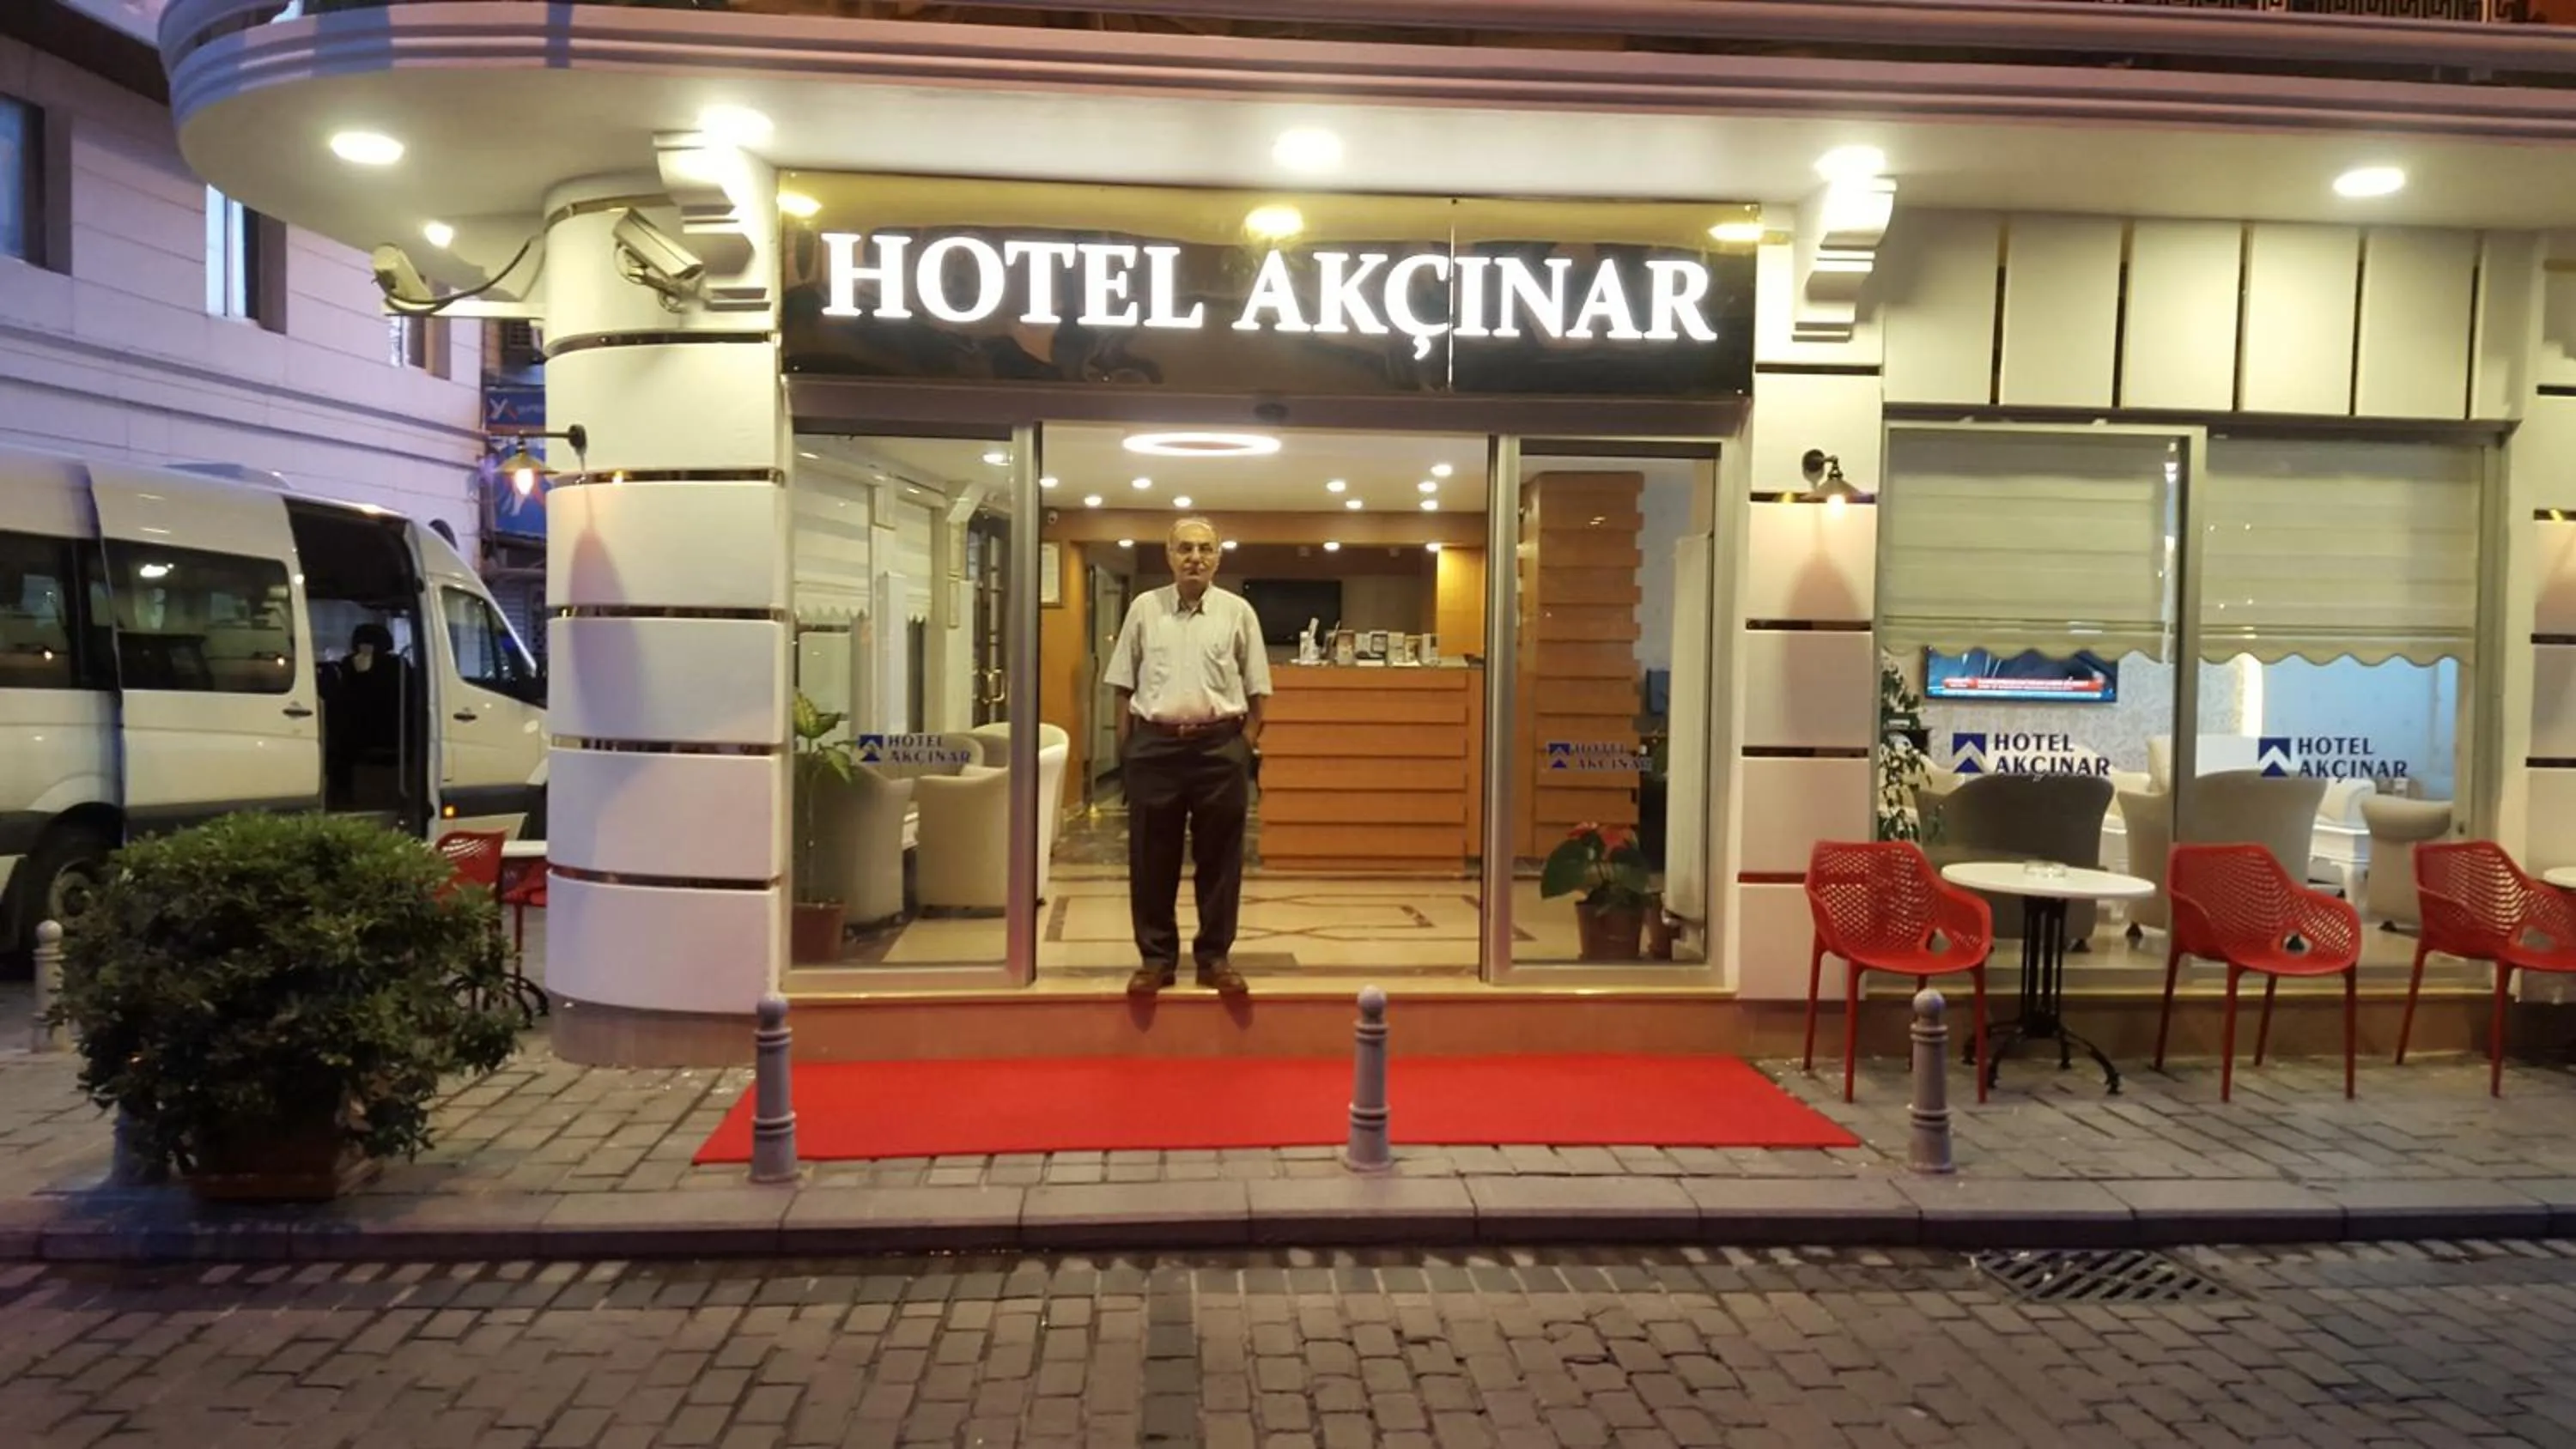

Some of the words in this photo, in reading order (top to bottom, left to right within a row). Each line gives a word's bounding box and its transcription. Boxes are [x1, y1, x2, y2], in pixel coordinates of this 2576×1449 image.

[821, 233, 1203, 330] HOTEL
[1231, 249, 1716, 360] AKÇINAR
[888, 735, 943, 749] HOTEL
[1995, 733, 2075, 752] HOTEL
[2298, 737, 2375, 755] HOTEL
[1995, 755, 2111, 782] AKÇINAR
[2298, 759, 2408, 783] AKÇINAR
